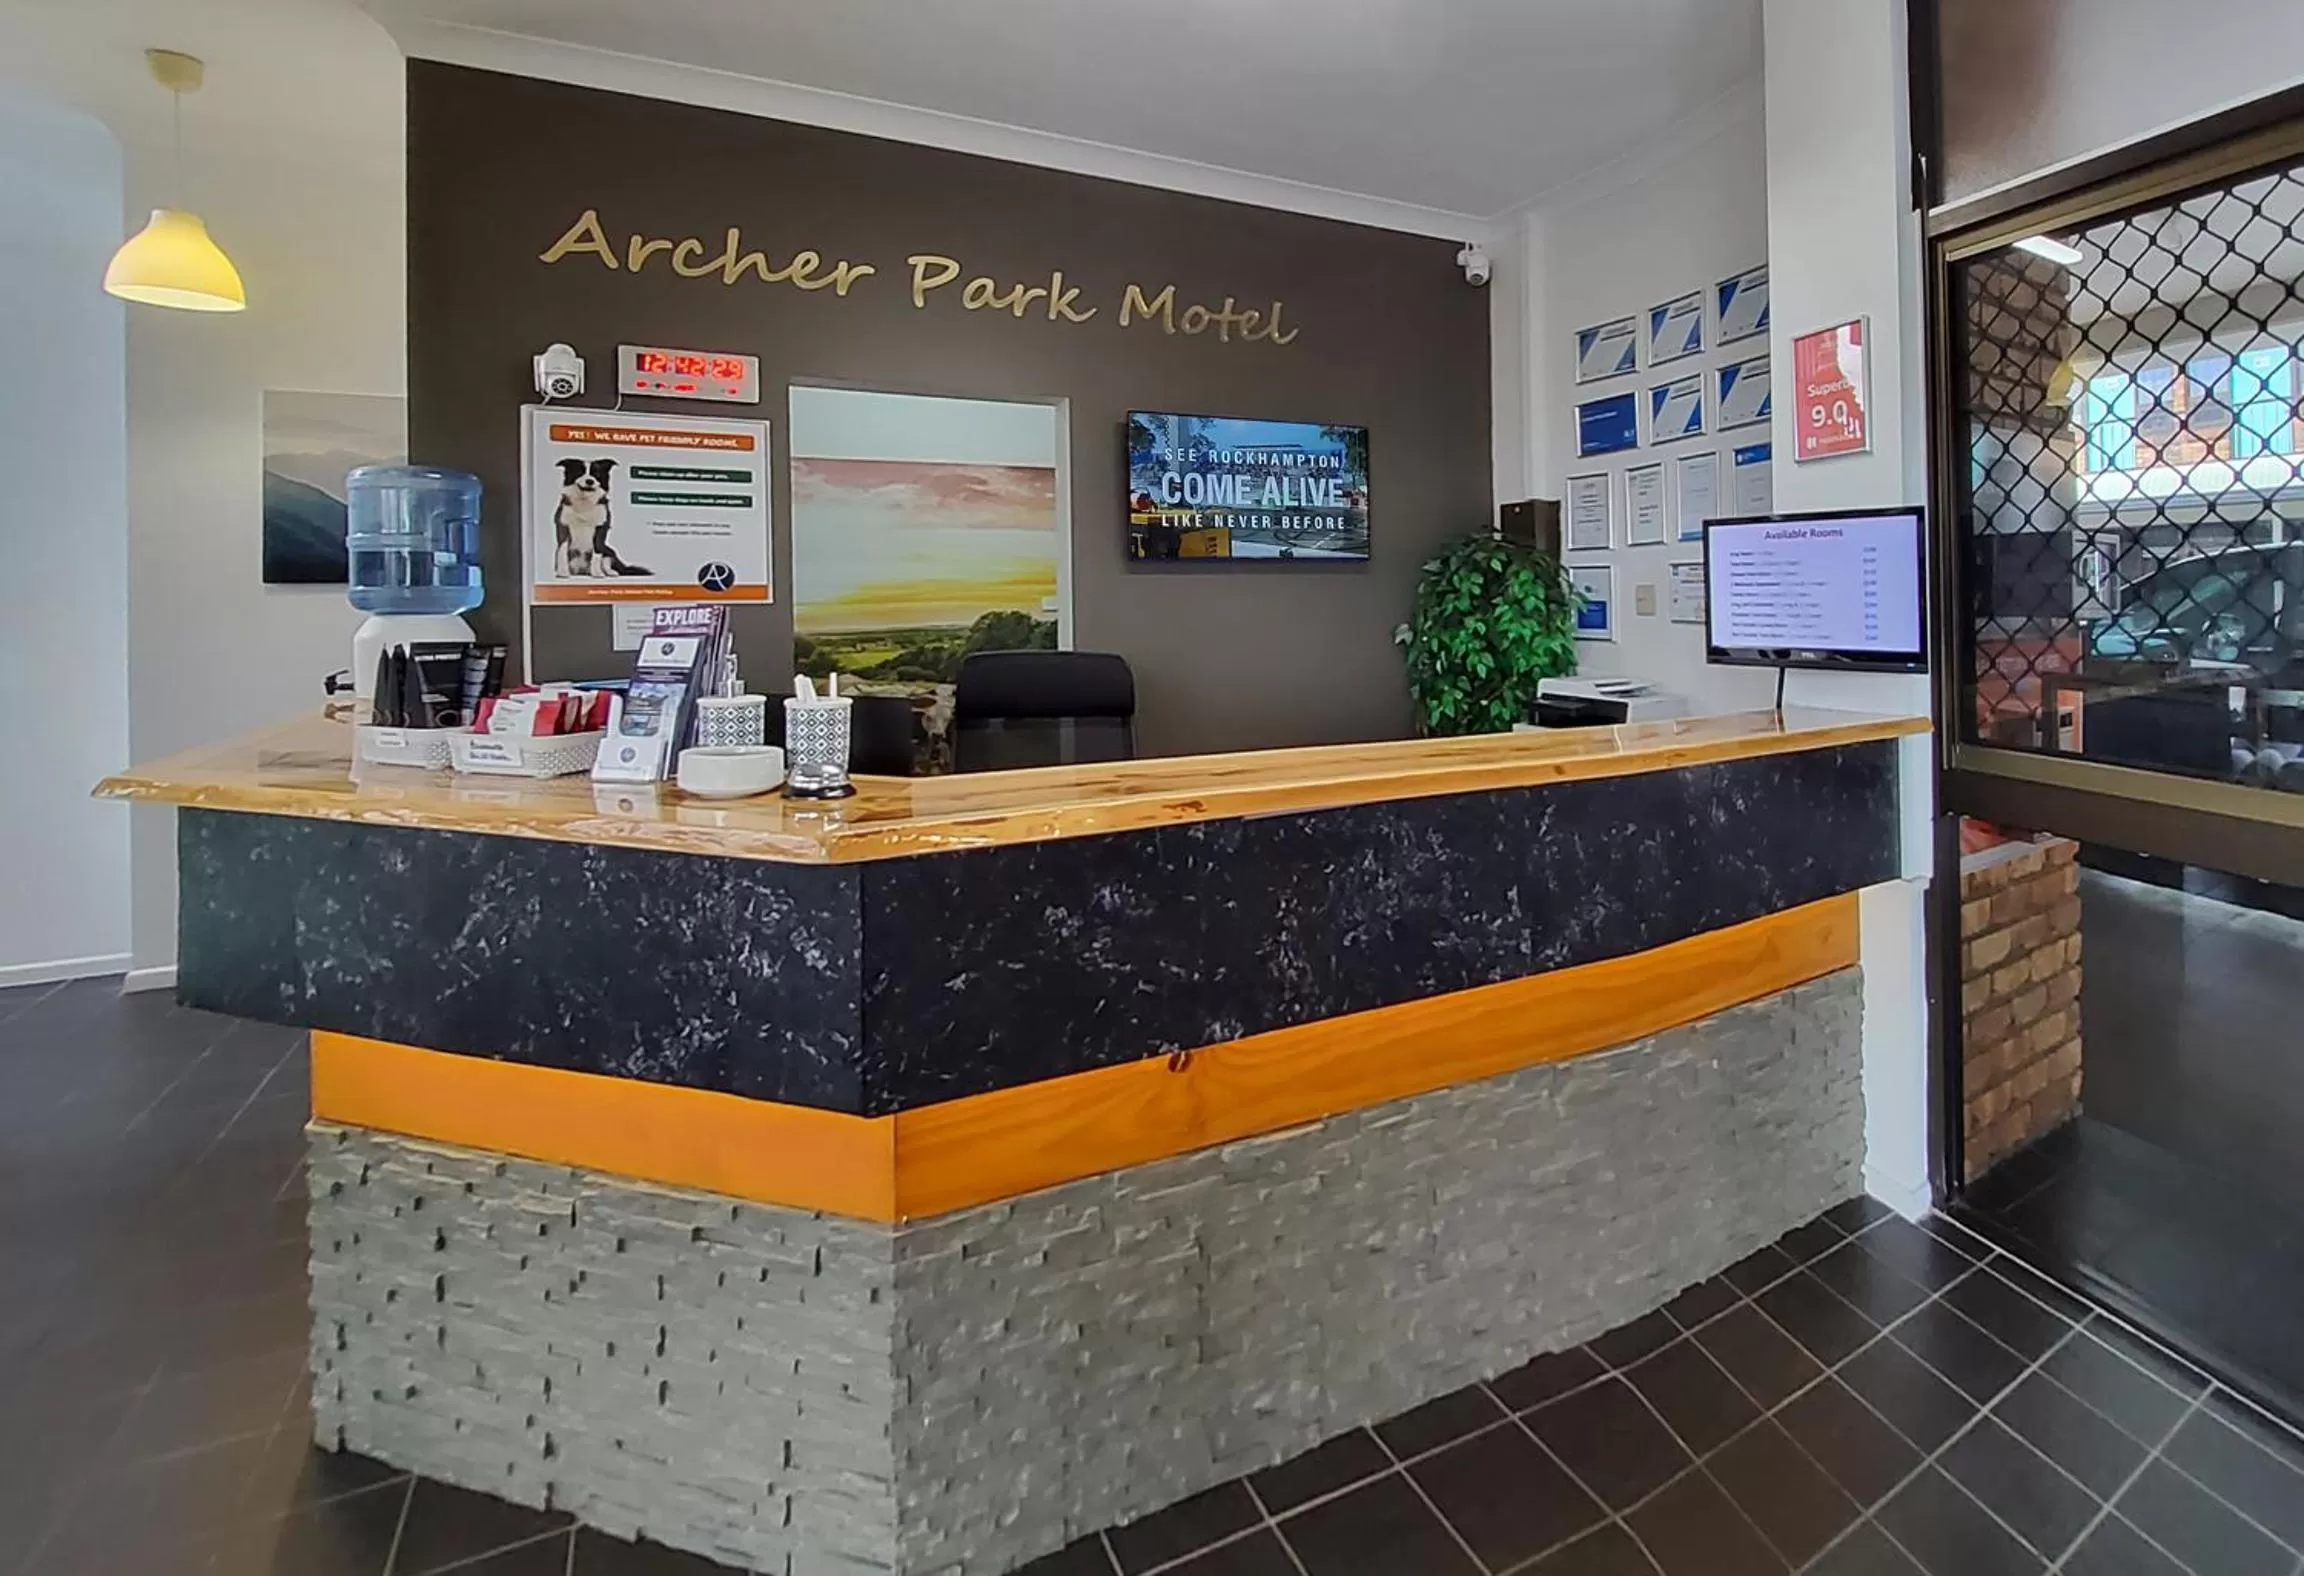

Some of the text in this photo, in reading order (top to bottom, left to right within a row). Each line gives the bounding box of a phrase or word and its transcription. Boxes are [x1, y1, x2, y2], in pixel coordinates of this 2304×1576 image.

[540, 209, 1301, 345] Archer Park Motel
[594, 431, 611, 441] WE
[640, 434, 656, 443] PET
[1165, 448, 1340, 468] SEE ROCKHAMPTON
[1162, 471, 1344, 507] COME ALIVE
[1162, 514, 1345, 530] LIKE NEVER BEFORE
[1764, 527, 1844, 541] Available Rooms
[655, 608, 712, 626] EXPLORE
